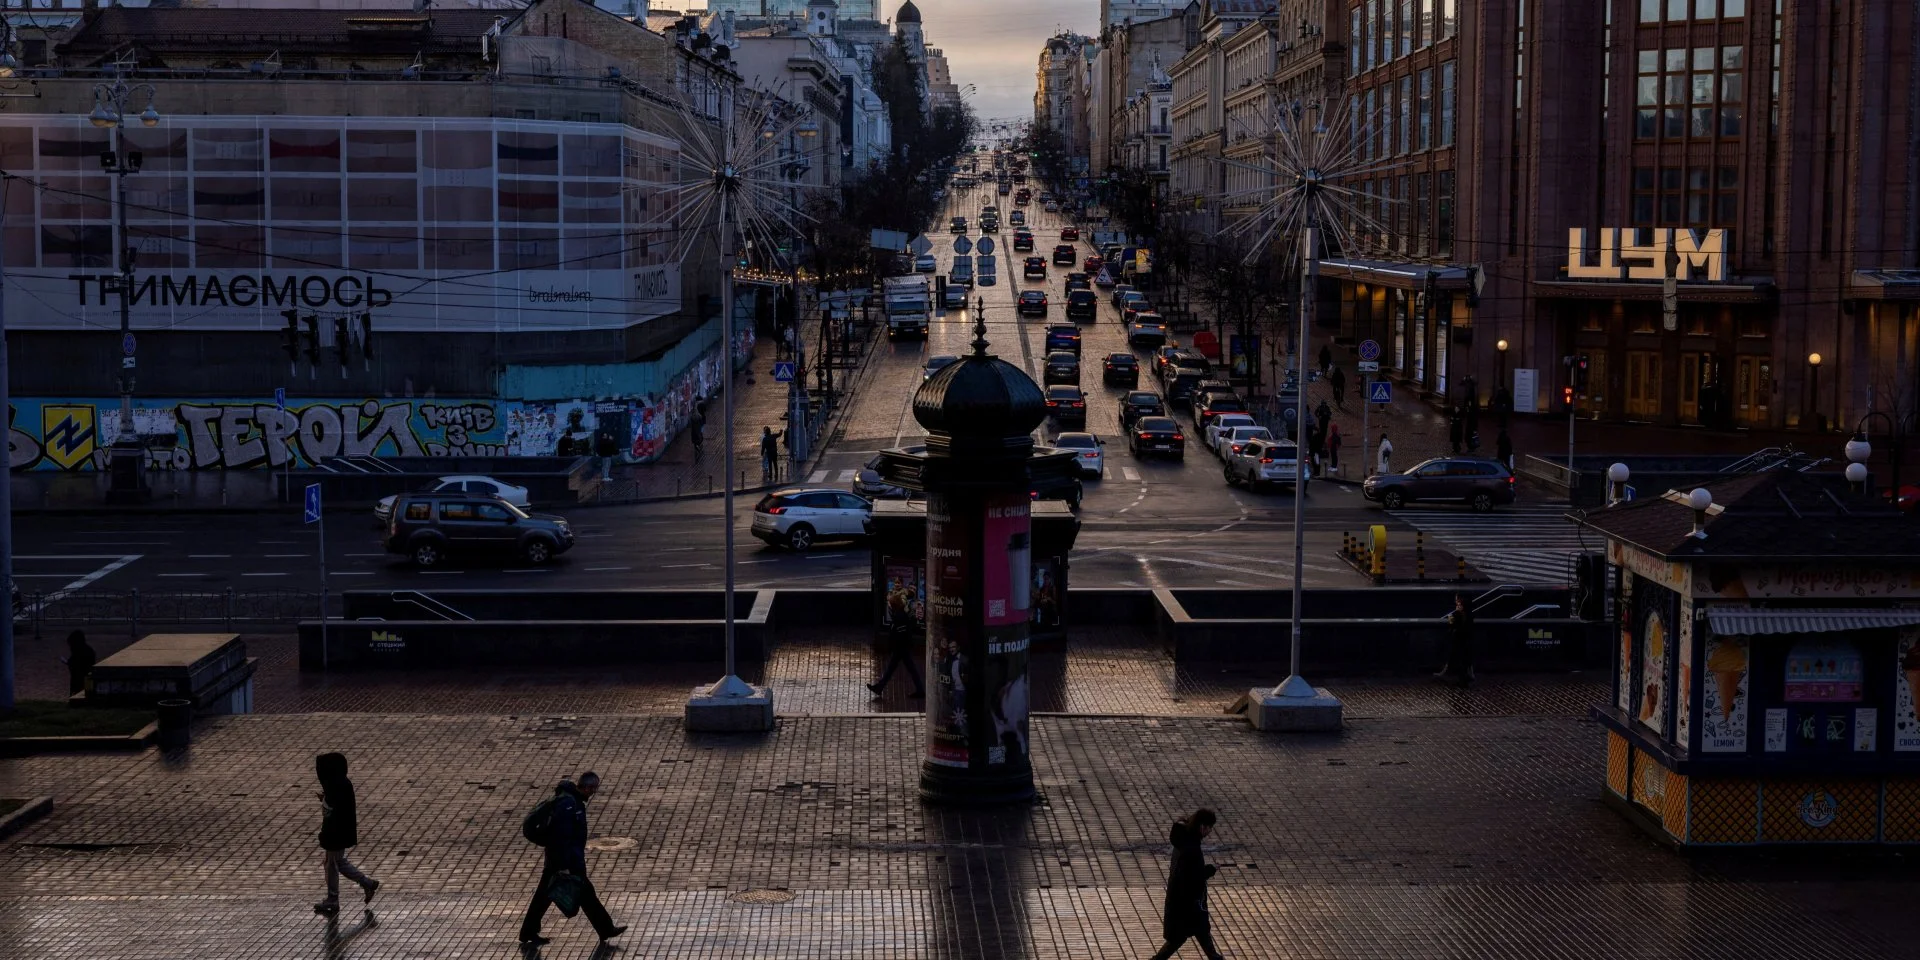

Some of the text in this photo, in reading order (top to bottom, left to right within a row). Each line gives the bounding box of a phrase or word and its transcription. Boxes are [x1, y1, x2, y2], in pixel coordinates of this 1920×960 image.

[1568, 227, 1727, 281] ЦУМ
[68, 275, 392, 307] ТРИМАЄМОСЬ
[1713, 739, 1735, 747] LEMON
